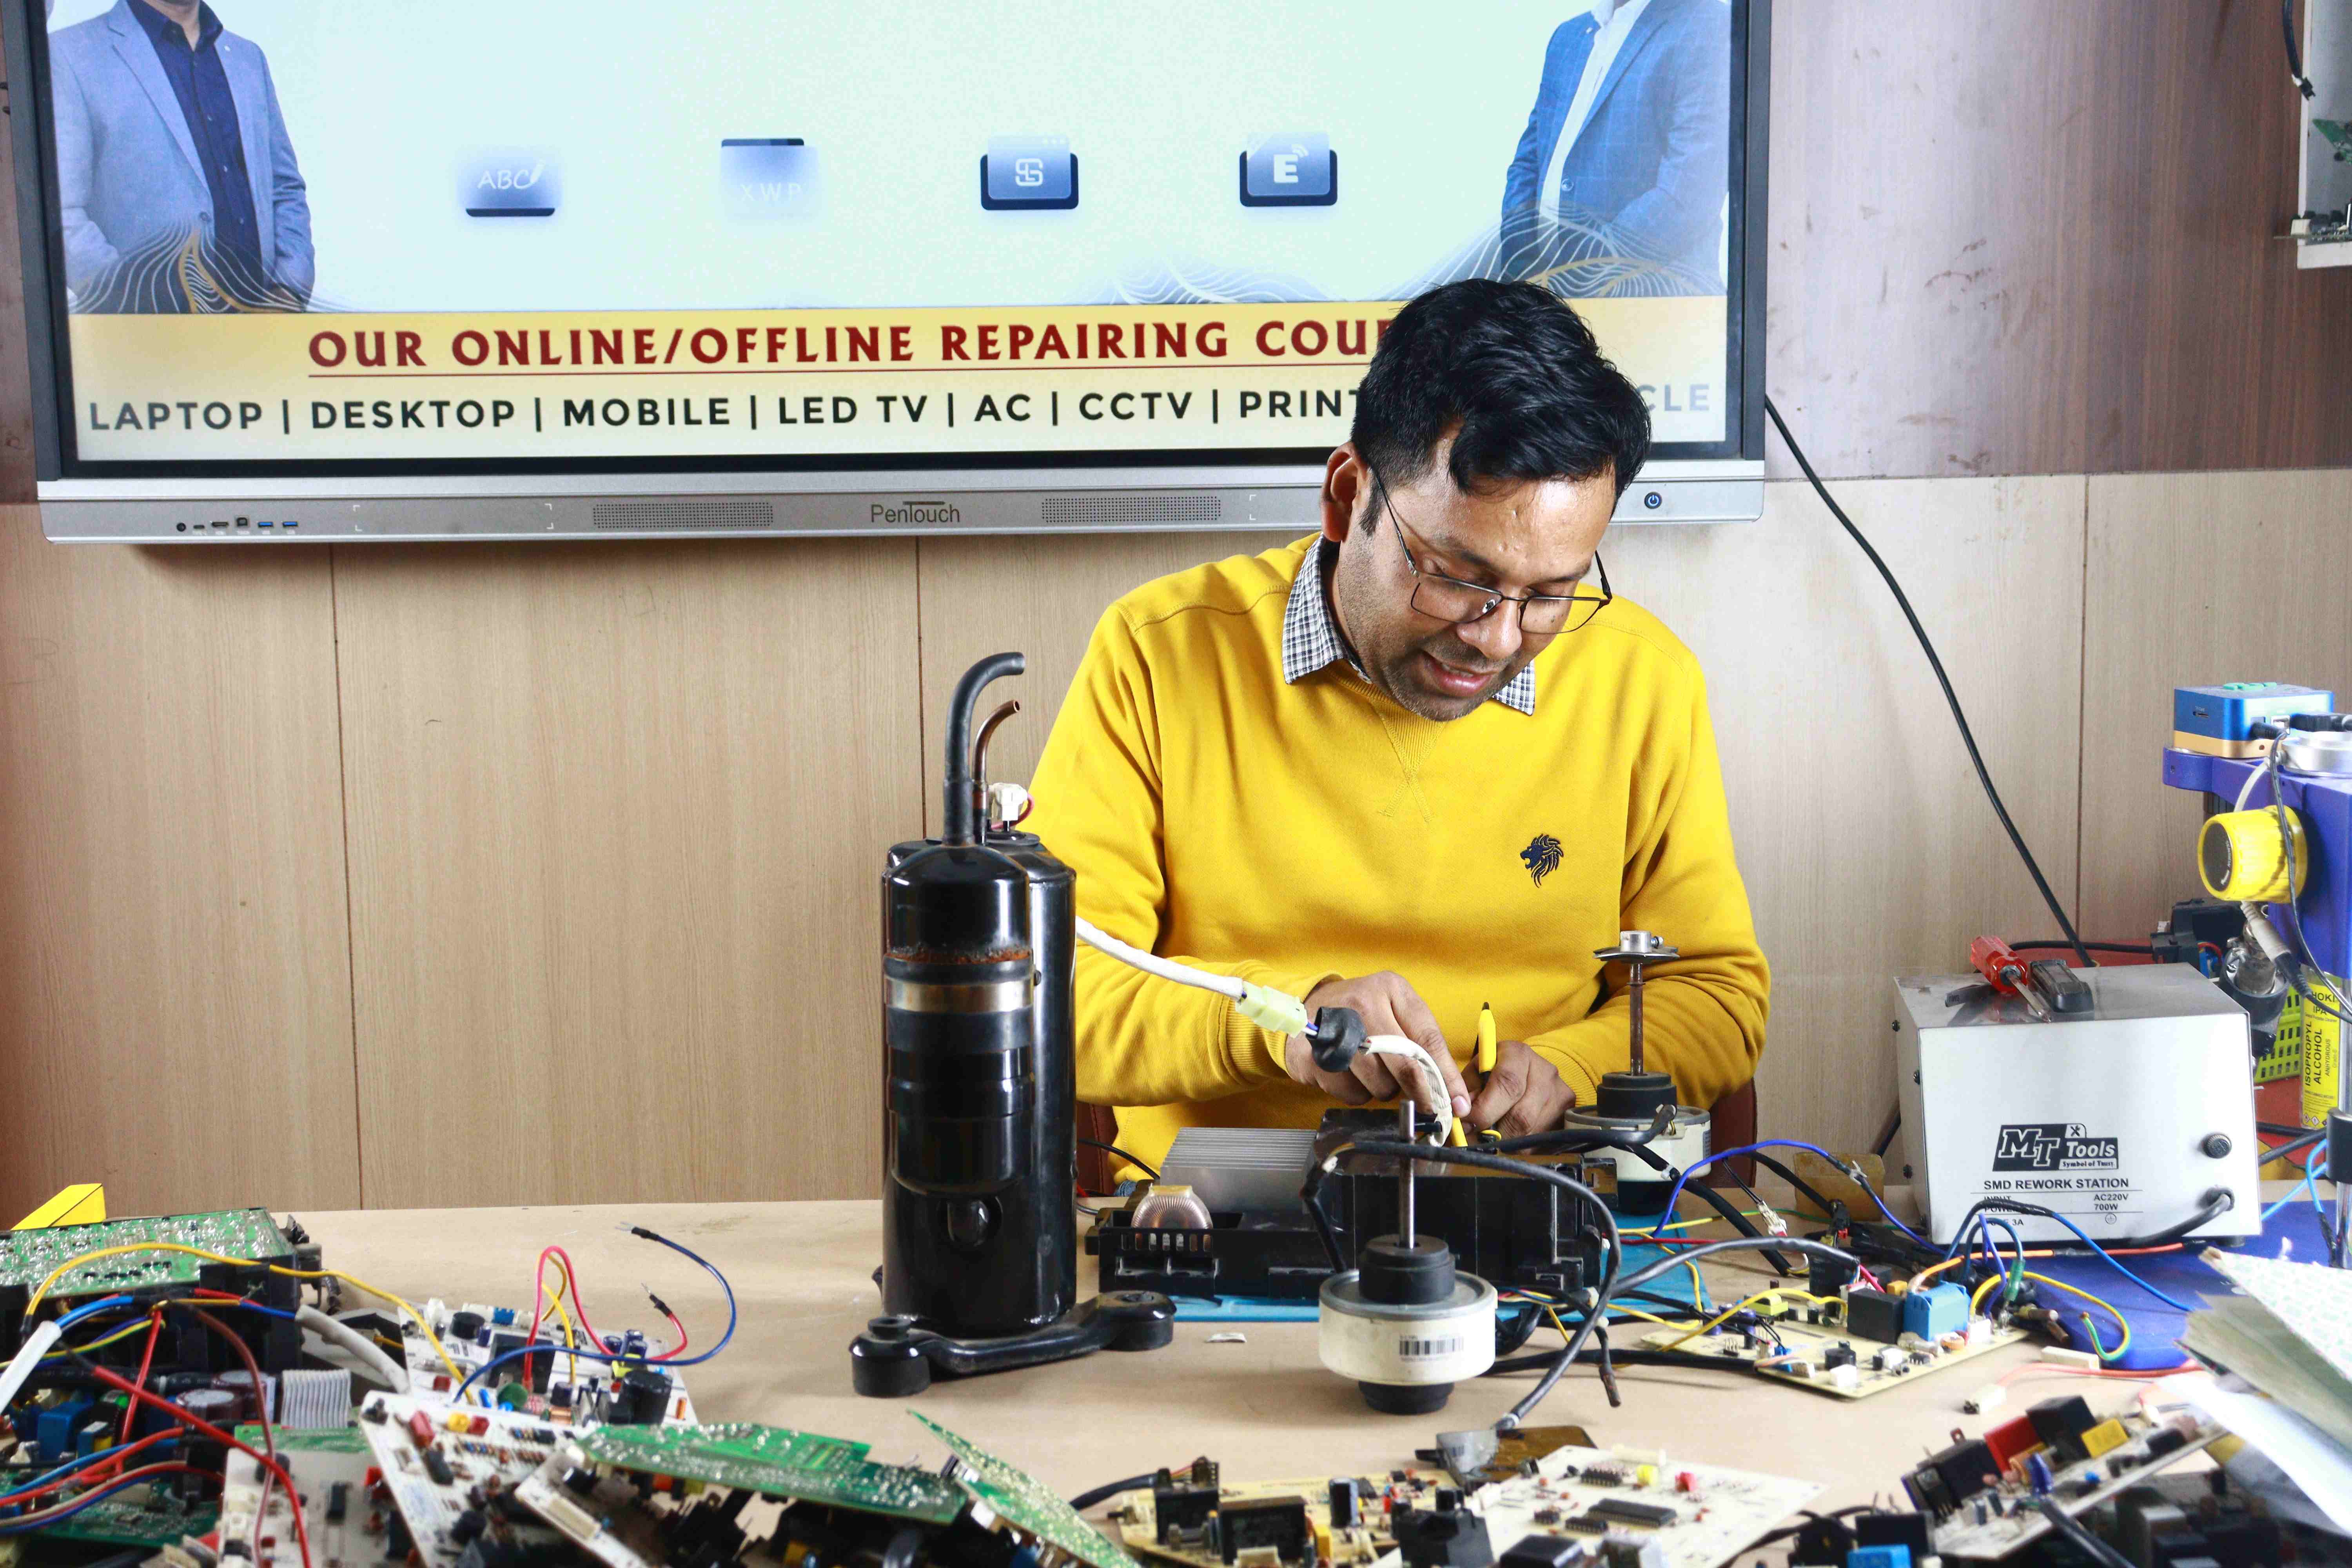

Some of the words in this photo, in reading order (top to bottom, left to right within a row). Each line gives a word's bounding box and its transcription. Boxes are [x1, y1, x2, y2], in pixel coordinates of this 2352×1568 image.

[477, 169, 532, 191] ABC
[309, 330, 427, 367] OUR
[452, 326, 914, 366] ONLINE/OFFLINE
[940, 321, 1228, 361] REPAIRING
[89, 400, 262, 430] LAPTOP
[312, 400, 515, 428] DESKTOP
[563, 397, 730, 426] MOBILE
[779, 396, 858, 424] LED
[876, 396, 927, 423] TV
[974, 394, 1031, 422] AC
[1079, 392, 1192, 420] CCTV
[871, 501, 960, 523] PenTouch
[2314, 1029, 2322, 1085] ALCOHOL
[1998, 1129, 2060, 1167] MT
[2066, 1141, 2116, 1158] Tools
[1984, 1180, 2011, 1190] SMD
[2016, 1179, 2072, 1189] REWORK
[2076, 1178, 2129, 1188] STATION
